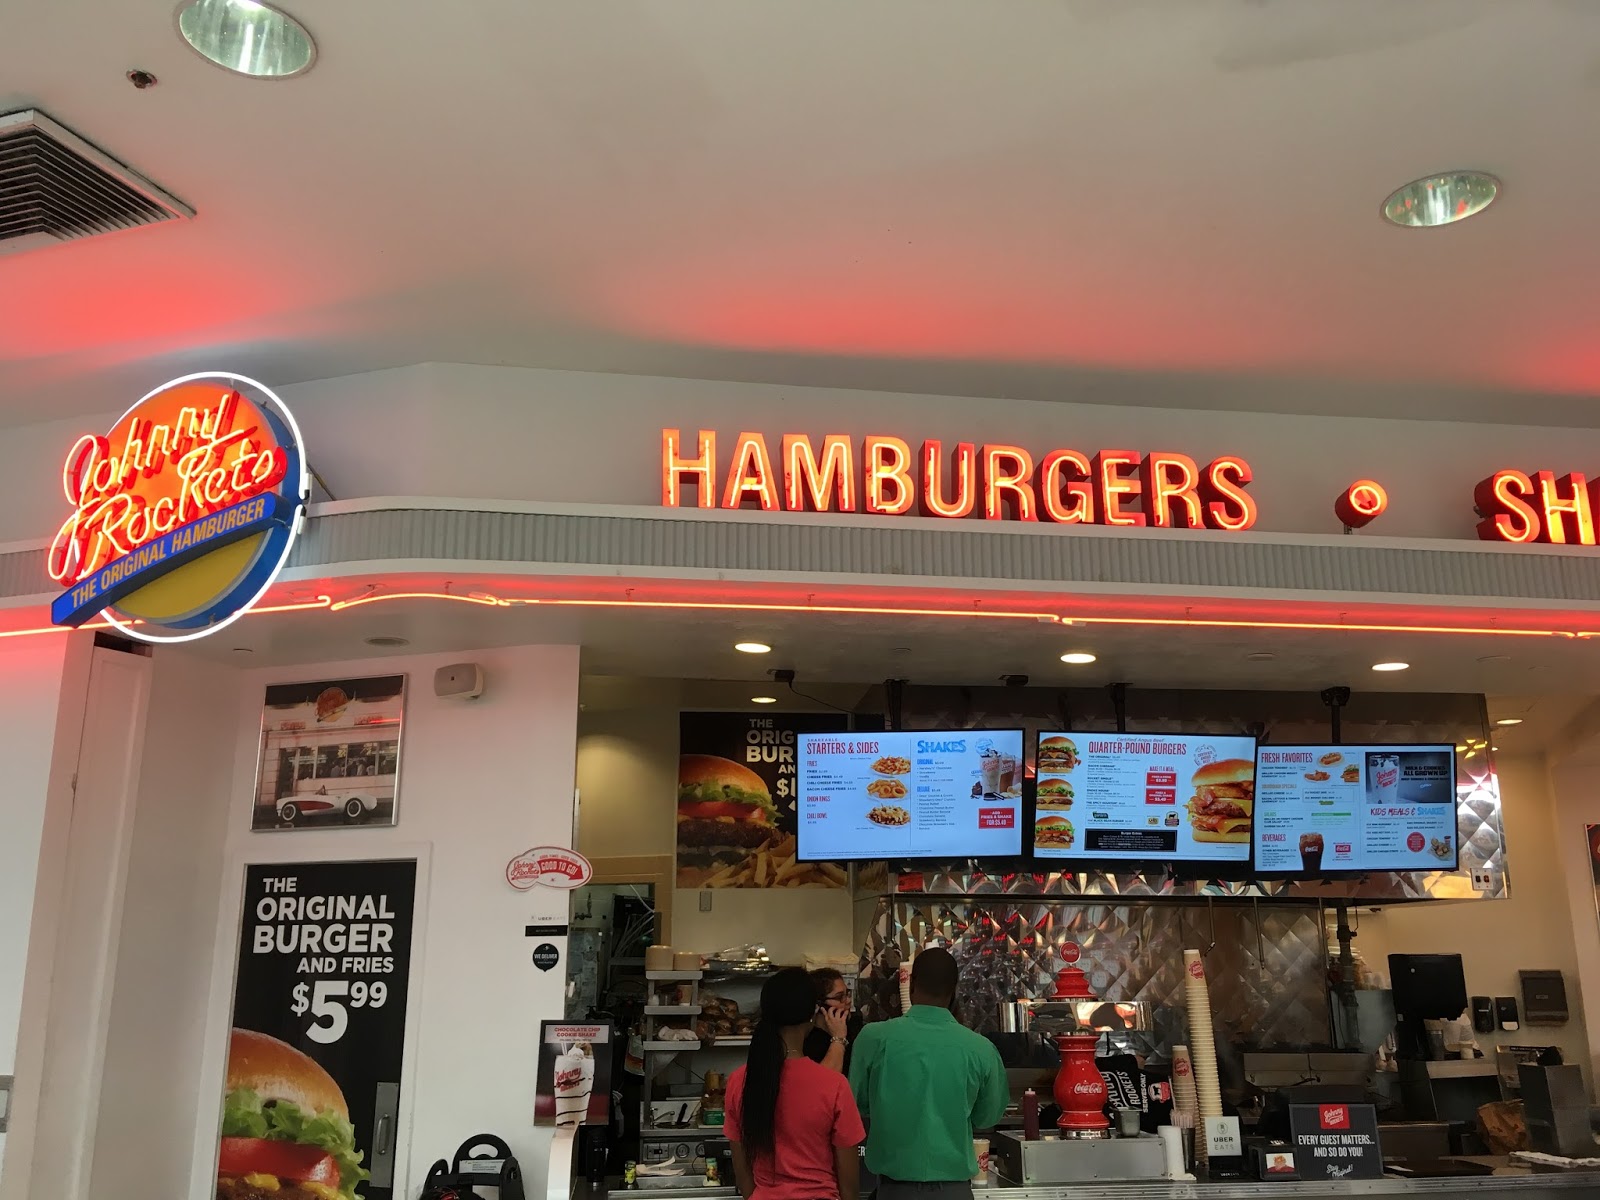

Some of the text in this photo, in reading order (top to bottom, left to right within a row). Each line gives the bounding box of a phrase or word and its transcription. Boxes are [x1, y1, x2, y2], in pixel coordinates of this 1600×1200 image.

[63, 391, 255, 505] Johnny
[662, 428, 1257, 531] HAMBURGERS
[48, 437, 282, 581] Rockets
[1488, 469, 1600, 545] SH
[71, 498, 265, 608] THE ORIGINAL HAMBURGER
[749, 719, 774, 728] THE
[746, 730, 794, 744] ORIG
[746, 746, 794, 762] BUR
[807, 742, 879, 754] STARTERS & SIDES
[917, 740, 966, 754] SHAKES
[1089, 741, 1186, 755] QUARTER-POUND BURGERS
[1261, 752, 1312, 763] FRESH FAVORITES
[778, 764, 796, 774] AN
[1371, 808, 1386, 816] KIDS
[1388, 808, 1410, 816] MEALS
[541, 861, 557, 871] GOOD
[559, 862, 566, 871] TO
[262, 877, 297, 893] THE
[256, 895, 395, 921] ORIGINAL
[253, 924, 394, 954] BURGER
[296, 957, 394, 973] AND FRIES
[1074, 1082, 1102, 1094] Coca-Cola
[1116, 1070, 1141, 1105] ROCKETS
[1324, 1108, 1343, 1120] Johnny
[1298, 1135, 1318, 1145] EVERY
[1320, 1135, 1340, 1145] GUEST
[1314, 1147, 1363, 1157] AND SO DO YOU!
